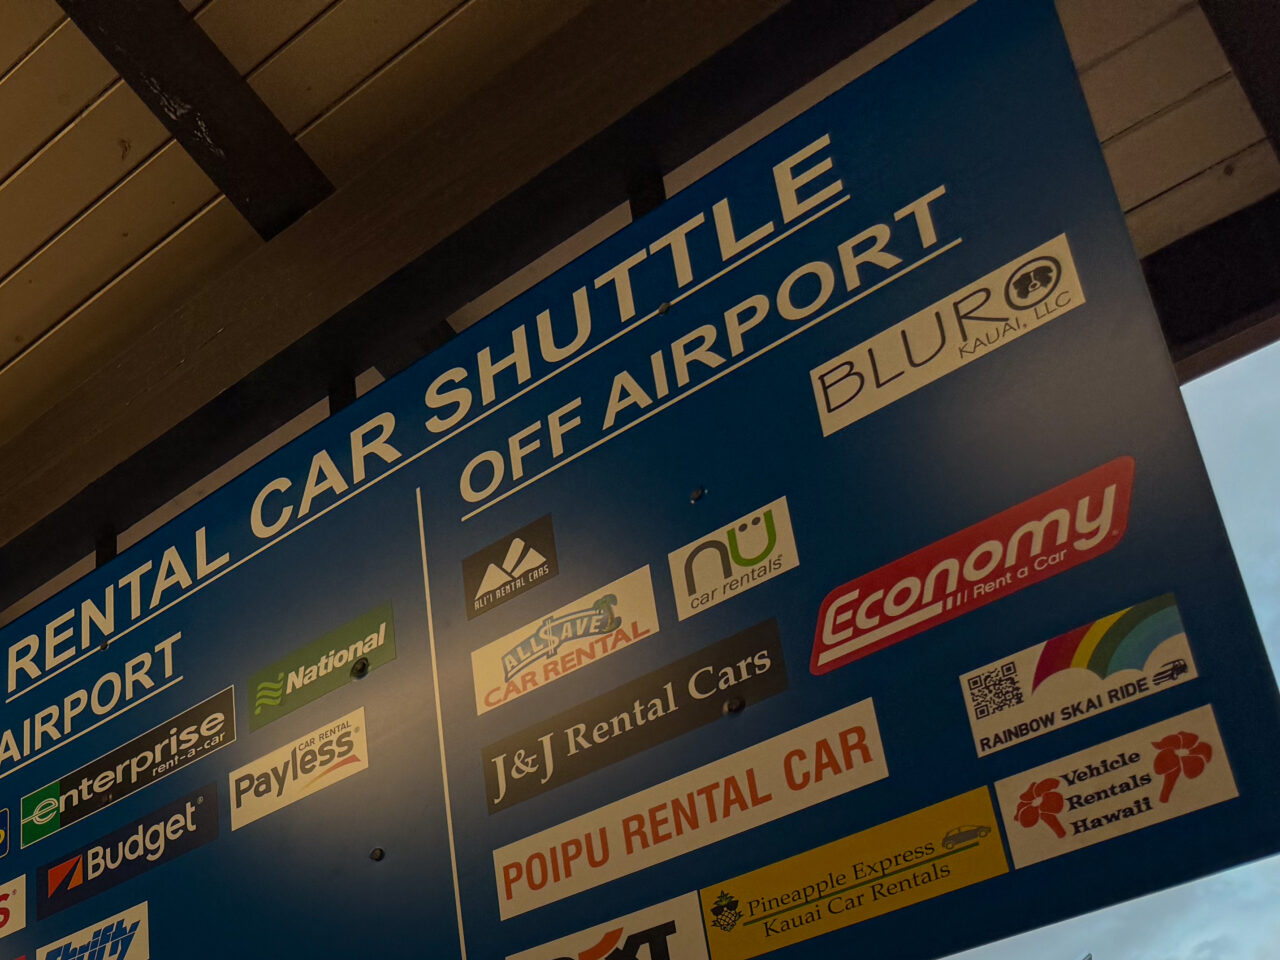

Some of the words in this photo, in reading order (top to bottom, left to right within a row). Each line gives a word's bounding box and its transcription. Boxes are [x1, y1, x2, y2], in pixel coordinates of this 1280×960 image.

[460, 407, 583, 505] OFF
[602, 185, 948, 431] AIRPORT
[958, 317, 1027, 359] KAUAI,
[1034, 290, 1072, 321] LLC
[6, 528, 231, 694] RENTAL
[250, 411, 402, 541] CAR
[424, 133, 845, 434] SHUTTLE
[496, 577, 525, 600] RENTAL
[528, 564, 549, 582] CARS
[690, 586, 718, 610] car
[722, 557, 783, 597] rentals
[821, 483, 1117, 646] Economy
[973, 574, 1013, 599] Rent
[1017, 567, 1029, 579] a
[1034, 548, 1067, 572] Car
[286, 622, 387, 696] National
[484, 672, 538, 708] CAR
[542, 621, 651, 682] RENTAL
[298, 738, 316, 752] CAR
[318, 720, 353, 742] RENTAL
[491, 732, 558, 804] J&J
[565, 682, 678, 757] Rental
[688, 649, 771, 701] Cars
[980, 712, 1055, 752] RAINBOW
[1060, 695, 1103, 721] SKAI
[1108, 677, 1150, 703] RIDE
[28, 711, 226, 825] enterprise
[152, 731, 226, 777] rent-a-car
[234, 730, 355, 809] Payless
[1060, 749, 1141, 786] Vehicle
[1066, 772, 1152, 811] Rentals
[87, 800, 197, 882] Budget
[502, 827, 609, 901] POIPU
[621, 768, 773, 855] RENTAL
[783, 724, 874, 792] CAR
[1071, 797, 1153, 836] Hawaii
[747, 872, 847, 918] Pineapple
[853, 841, 936, 881] Express
[763, 909, 822, 939] Kauai
[828, 893, 865, 916] Car
[871, 861, 951, 900] Rentals
